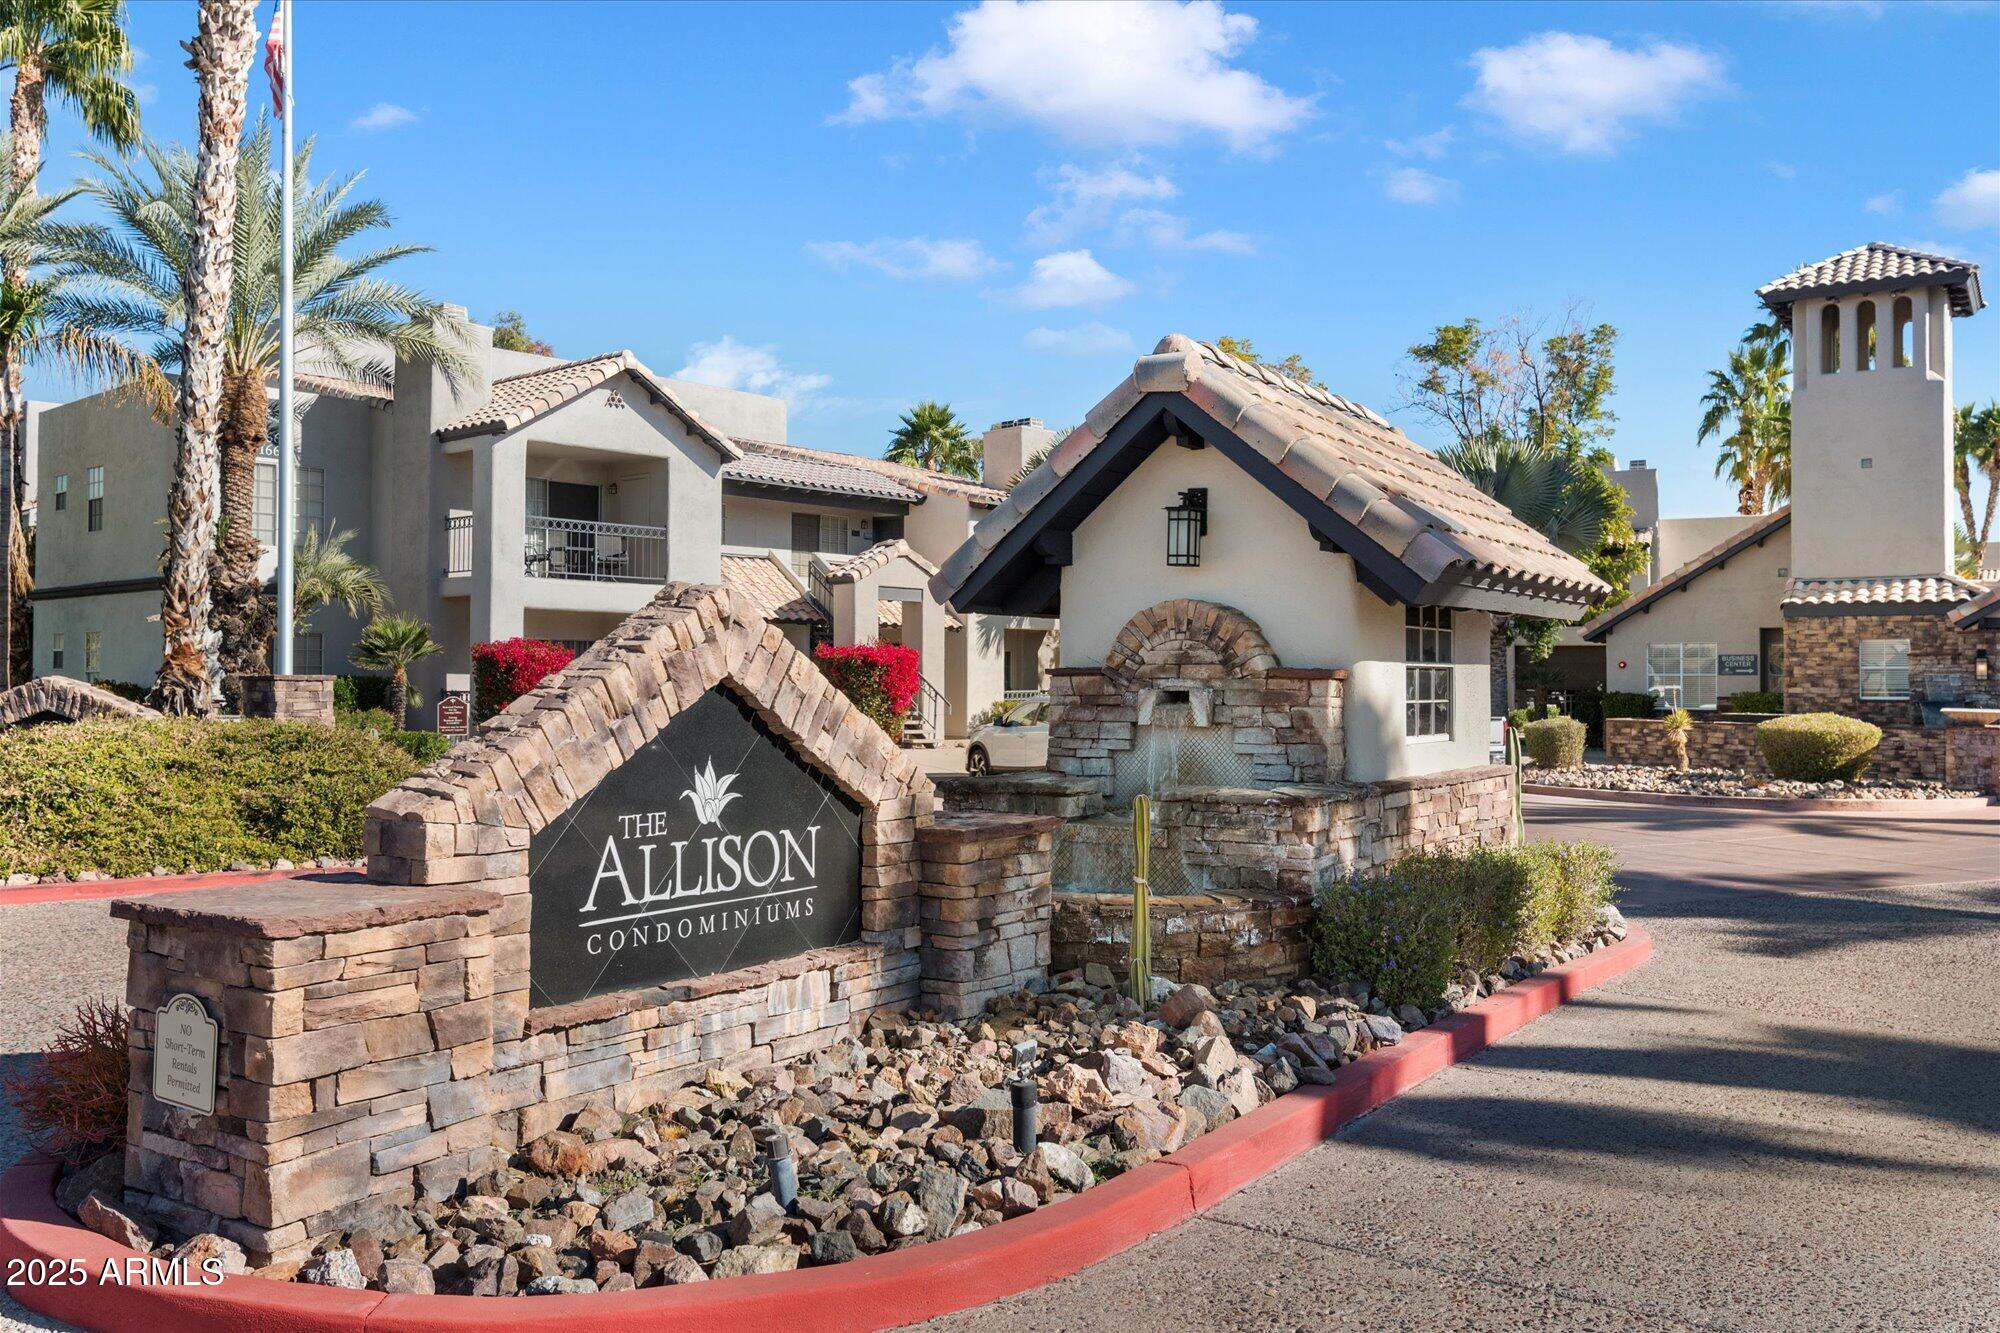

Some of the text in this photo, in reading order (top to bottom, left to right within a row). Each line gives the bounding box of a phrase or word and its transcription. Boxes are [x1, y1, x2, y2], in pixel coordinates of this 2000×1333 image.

[618, 811, 668, 839] THE
[579, 826, 821, 912] ALLISON
[586, 898, 814, 955] CONDOMINIUMS
[180, 1023, 192, 1037] NO
[164, 1037, 206, 1059] Short-Term
[171, 1057, 198, 1075] Rentals
[166, 1074, 201, 1094] Permitted
